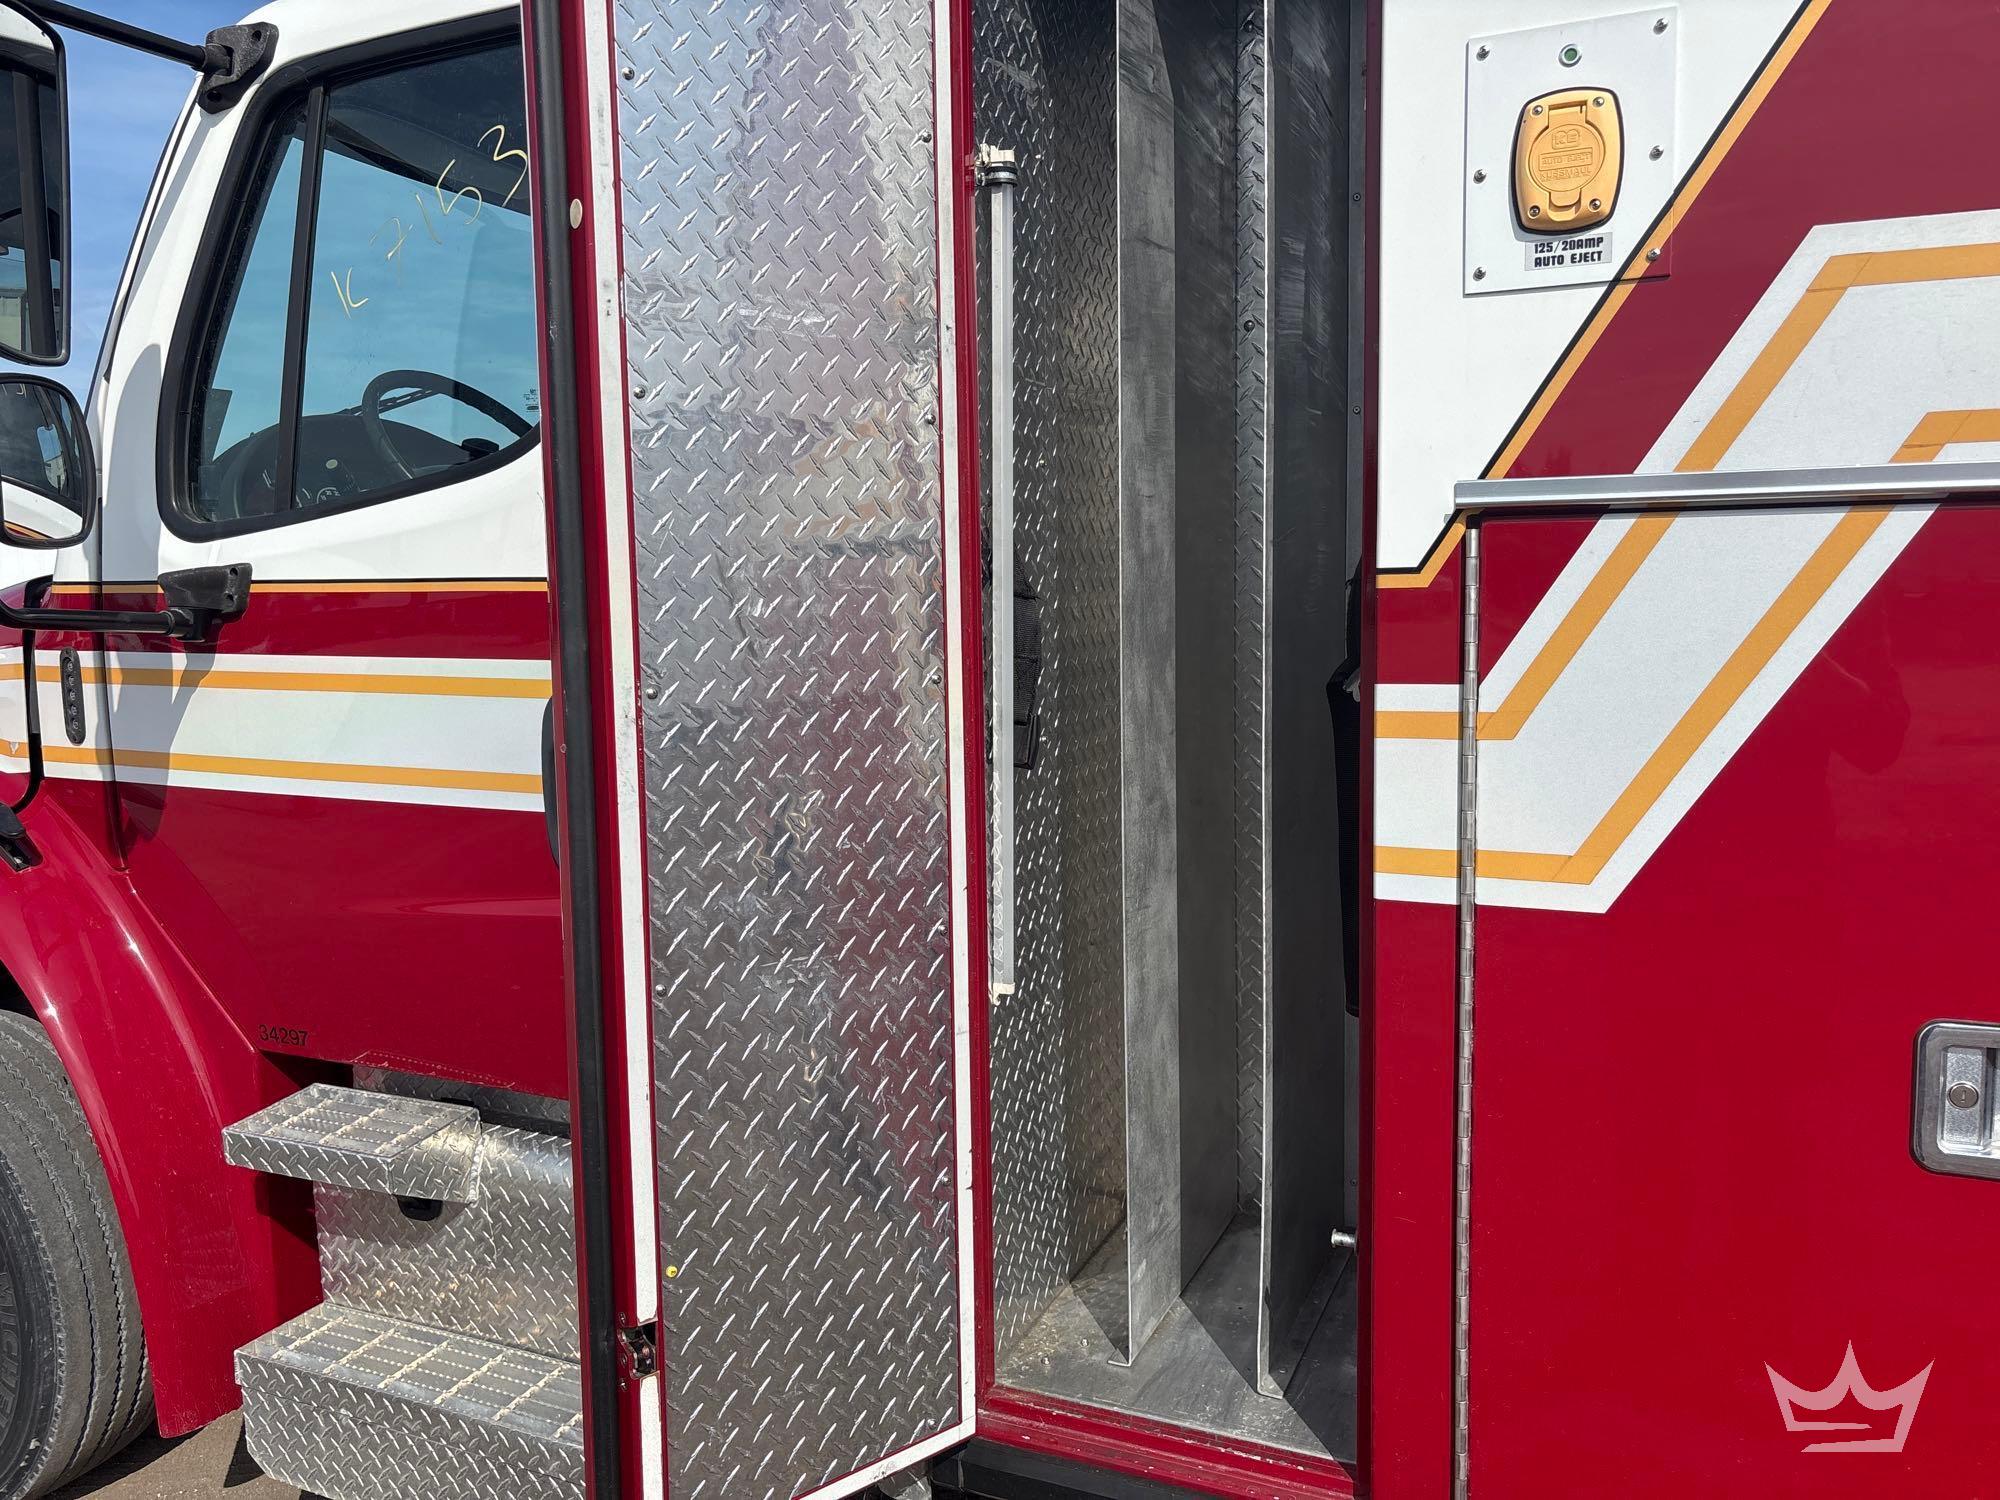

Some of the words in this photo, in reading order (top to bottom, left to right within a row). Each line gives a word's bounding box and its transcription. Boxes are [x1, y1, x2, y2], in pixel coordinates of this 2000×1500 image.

[1534, 236, 1604, 254] 125/20AMP
[1534, 254, 1565, 268] AUTO
[1570, 250, 1603, 264] EJECT
[259, 1024, 308, 1047] 34297
